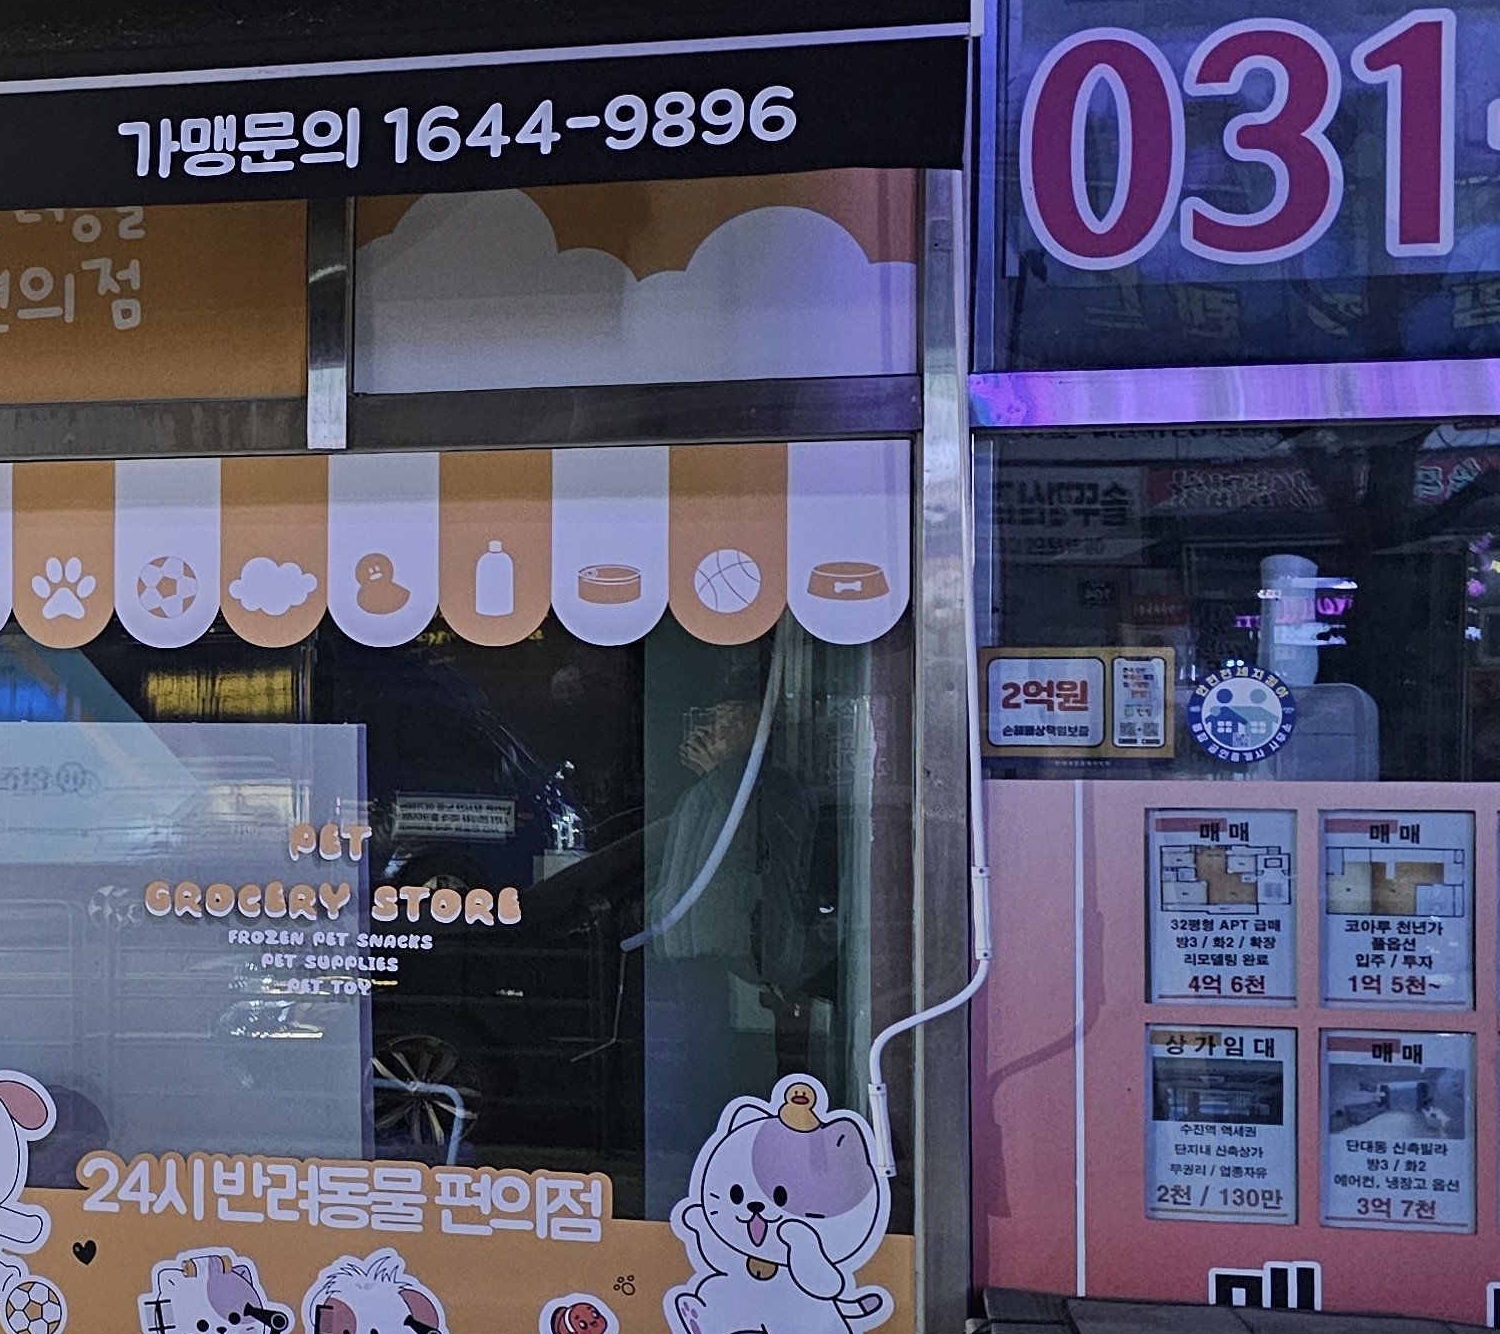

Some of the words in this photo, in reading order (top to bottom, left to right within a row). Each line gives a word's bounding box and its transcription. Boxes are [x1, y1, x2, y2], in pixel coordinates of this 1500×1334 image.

[118, 107, 361, 178] 가맹문의
[383, 86, 797, 167] 1644-9896
[1002, 679, 1089, 712] 2억원
[289, 823, 372, 861] PET
[144, 880, 351, 921] GROCERY
[371, 885, 522, 925] STORE
[1219, 919, 1249, 931] APT
[1253, 918, 1282, 932] 급매
[228, 929, 304, 946] FROZEN
[312, 931, 349, 948] PET
[356, 933, 433, 950] SNACKS
[1176, 936, 1198, 950] 방3
[1212, 936, 1235, 950] 화2
[261, 952, 298, 969] PET
[305, 954, 399, 972] SUPPLIES
[1184, 953, 1238, 966] 리모델링
[1242, 953, 1270, 966] 완료
[1355, 954, 1386, 969] 입주
[1401, 954, 1434, 970] 투자
[287, 978, 323, 995] PET
[330, 979, 372, 996] TOY
[1188, 974, 1223, 995] 4억
[1230, 974, 1267, 995] 6천
[1348, 974, 1382, 995] 1억
[1180, 1123, 1217, 1137] 수진역
[1174, 1143, 1211, 1157] 단지내
[1215, 1144, 1265, 1159] 신축상가
[1346, 1139, 1388, 1154] 단대동
[1366, 1158, 1389, 1172] 방3
[1404, 1159, 1428, 1173] 화2
[82, 1157, 204, 1221] 24시
[214, 1161, 427, 1234] 반려동물
[435, 1172, 603, 1241] 편의점
[1156, 1184, 1193, 1207] 2천
[1219, 1187, 1284, 1210] 130만
[1357, 1197, 1392, 1219] 3억
[1401, 1199, 1437, 1220] 7천
